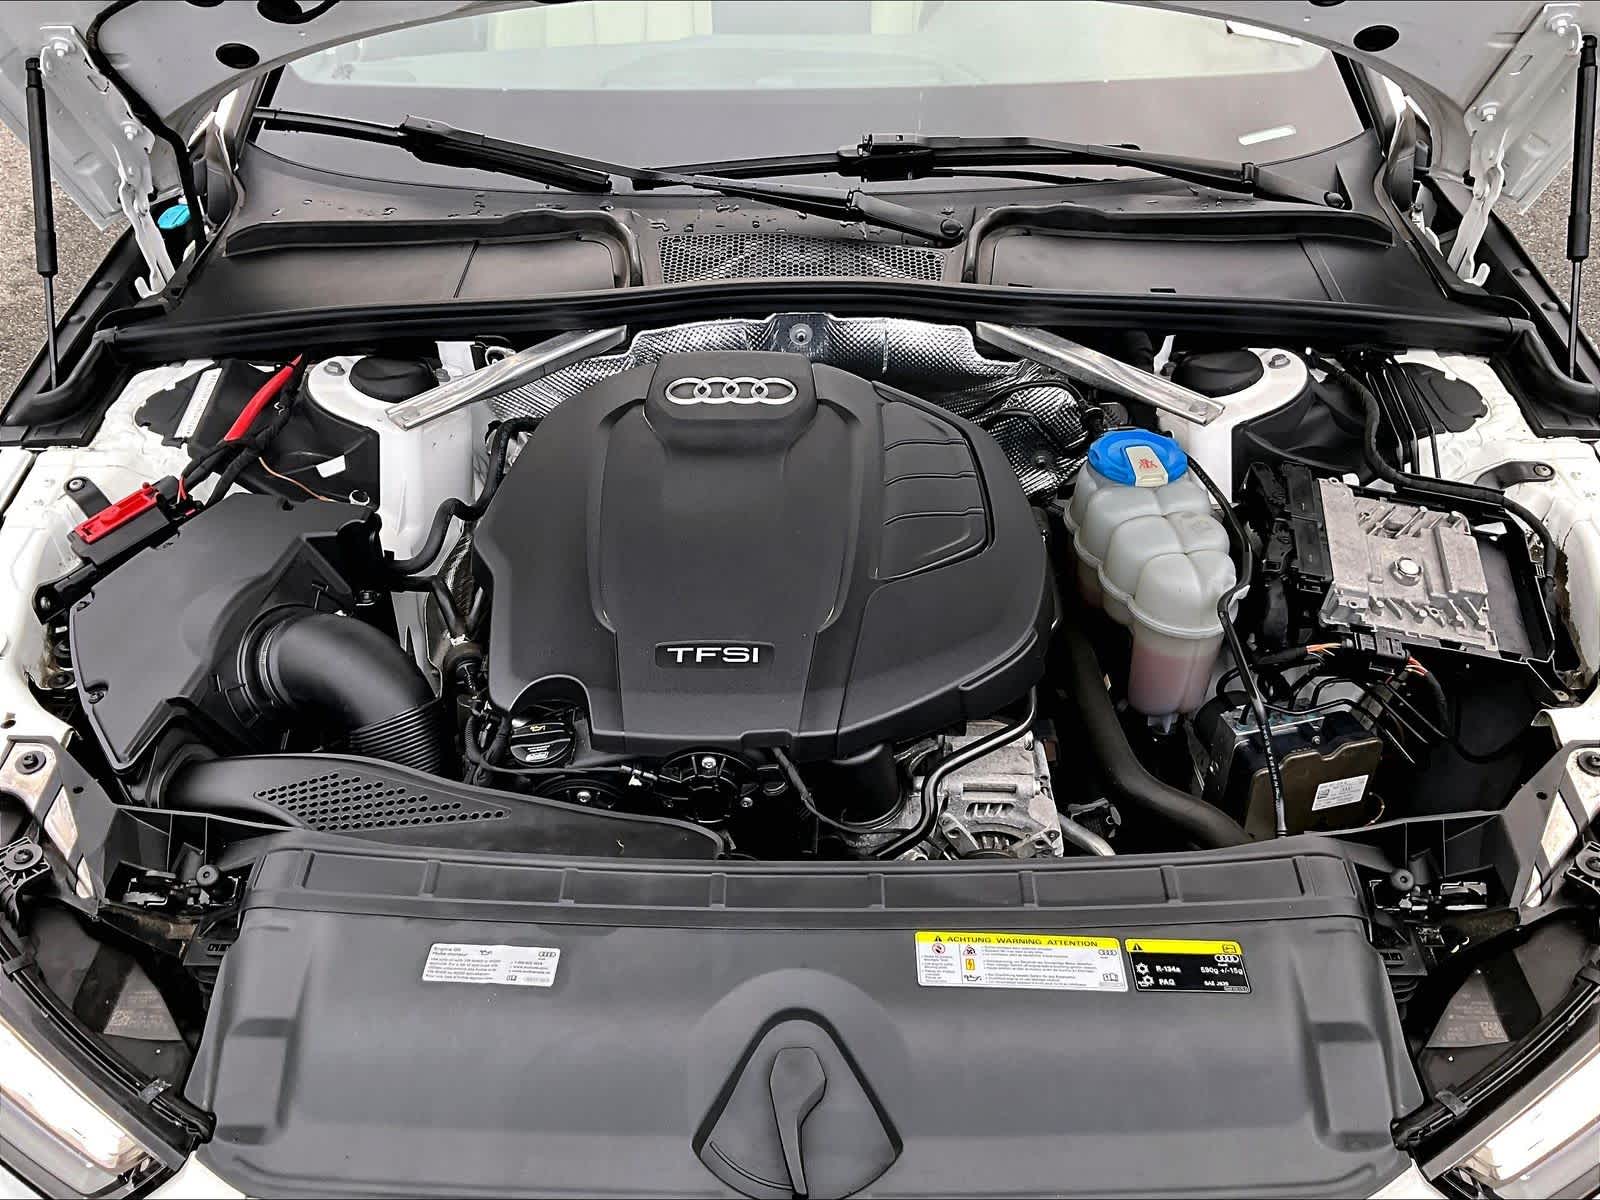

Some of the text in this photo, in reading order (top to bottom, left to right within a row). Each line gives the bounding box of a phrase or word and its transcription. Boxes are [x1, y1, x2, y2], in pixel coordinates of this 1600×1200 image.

[667, 647, 759, 663] TFSI
[947, 935, 1098, 947] ACHTUNG WARNING ATTENTION
